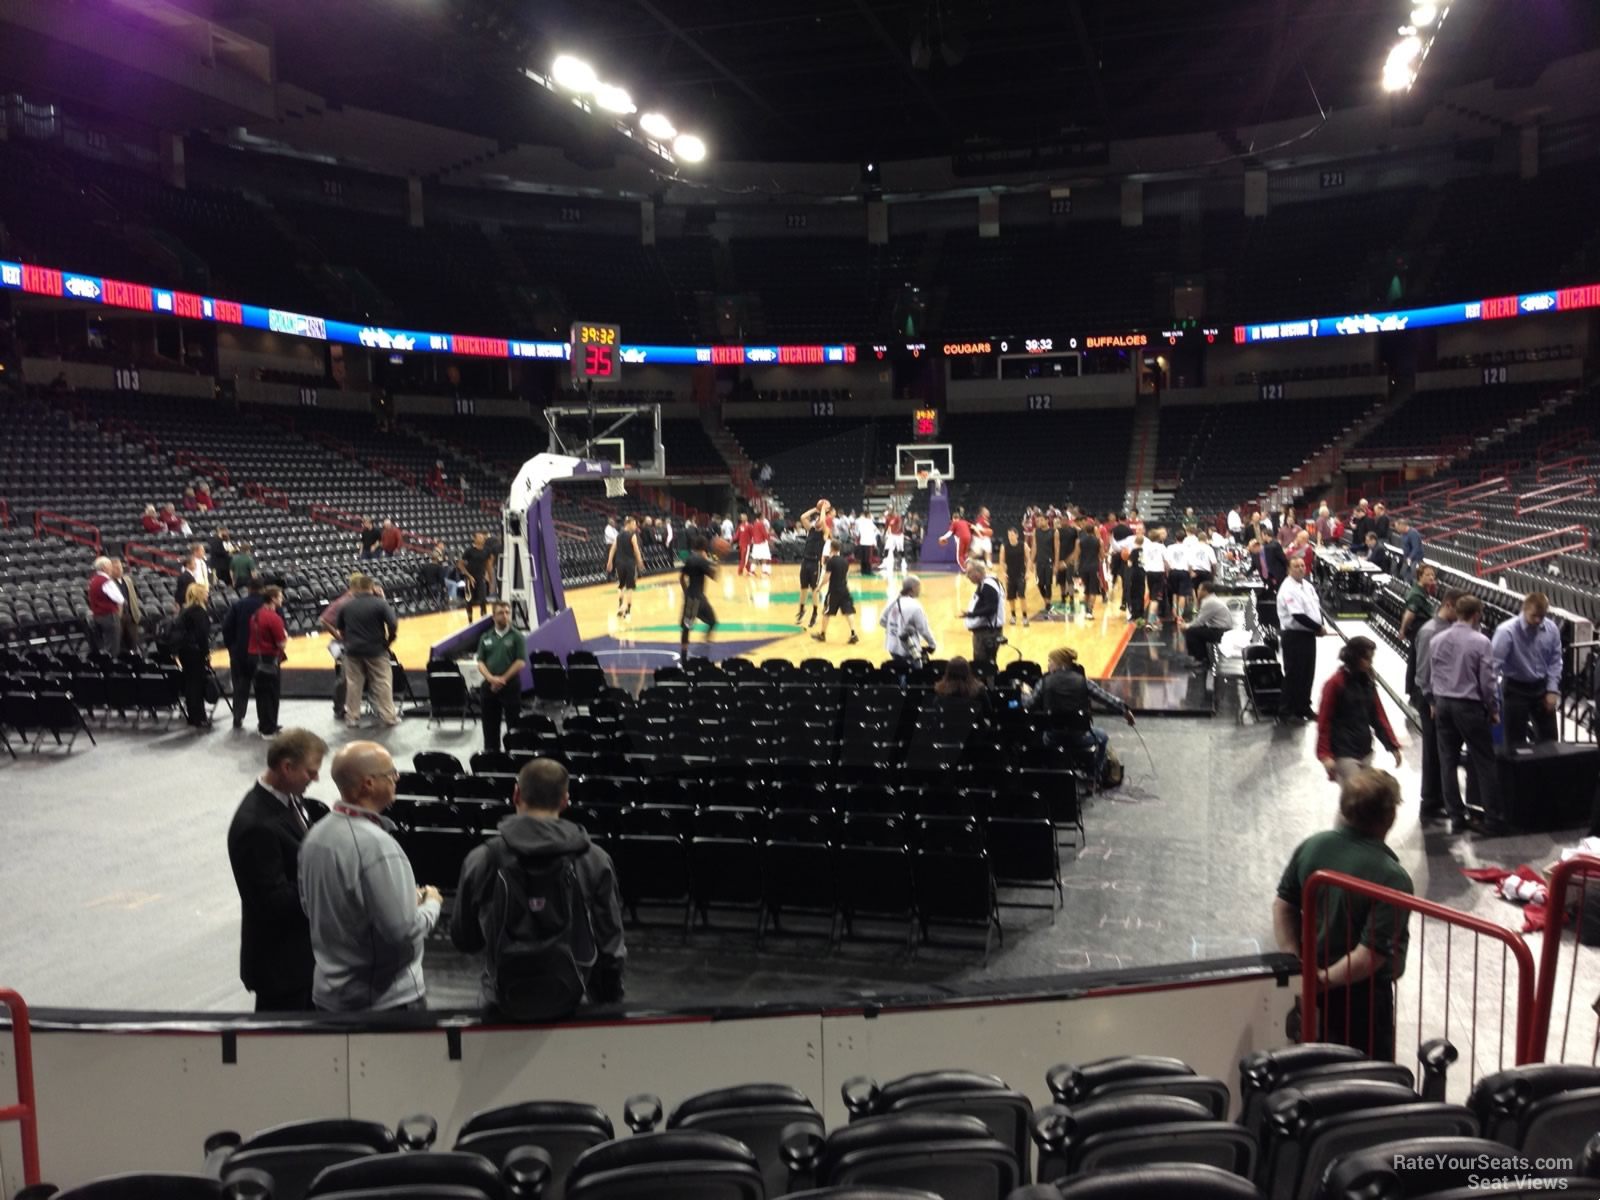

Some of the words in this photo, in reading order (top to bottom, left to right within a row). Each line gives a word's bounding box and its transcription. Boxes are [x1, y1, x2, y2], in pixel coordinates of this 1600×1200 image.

[1323, 172, 1342, 187] 221
[22, 263, 62, 297] KHEAD
[102, 278, 153, 311] LOCATION
[173, 291, 203, 319] ISSUE
[1481, 296, 1518, 320] KHEAD
[581, 326, 615, 345] 39:32
[944, 343, 991, 355] COUGARS
[1001, 341, 1008, 352] 0
[1070, 338, 1077, 348] 0
[1086, 334, 1148, 348] BUFFALOES
[1169, 336, 1176, 345] 0
[452, 335, 508, 358] KNUCKLEHEAD
[712, 346, 744, 364] KHEAD
[778, 346, 824, 364] LOCATION
[913, 349, 919, 358] 0
[585, 346, 612, 376] 35
[116, 369, 140, 391] 103
[1484, 367, 1506, 384] 120
[301, 388, 317, 406] 102
[1262, 384, 1282, 400] 121
[457, 399, 474, 415] 101
[813, 402, 834, 416] 123
[1030, 395, 1051, 410] 122
